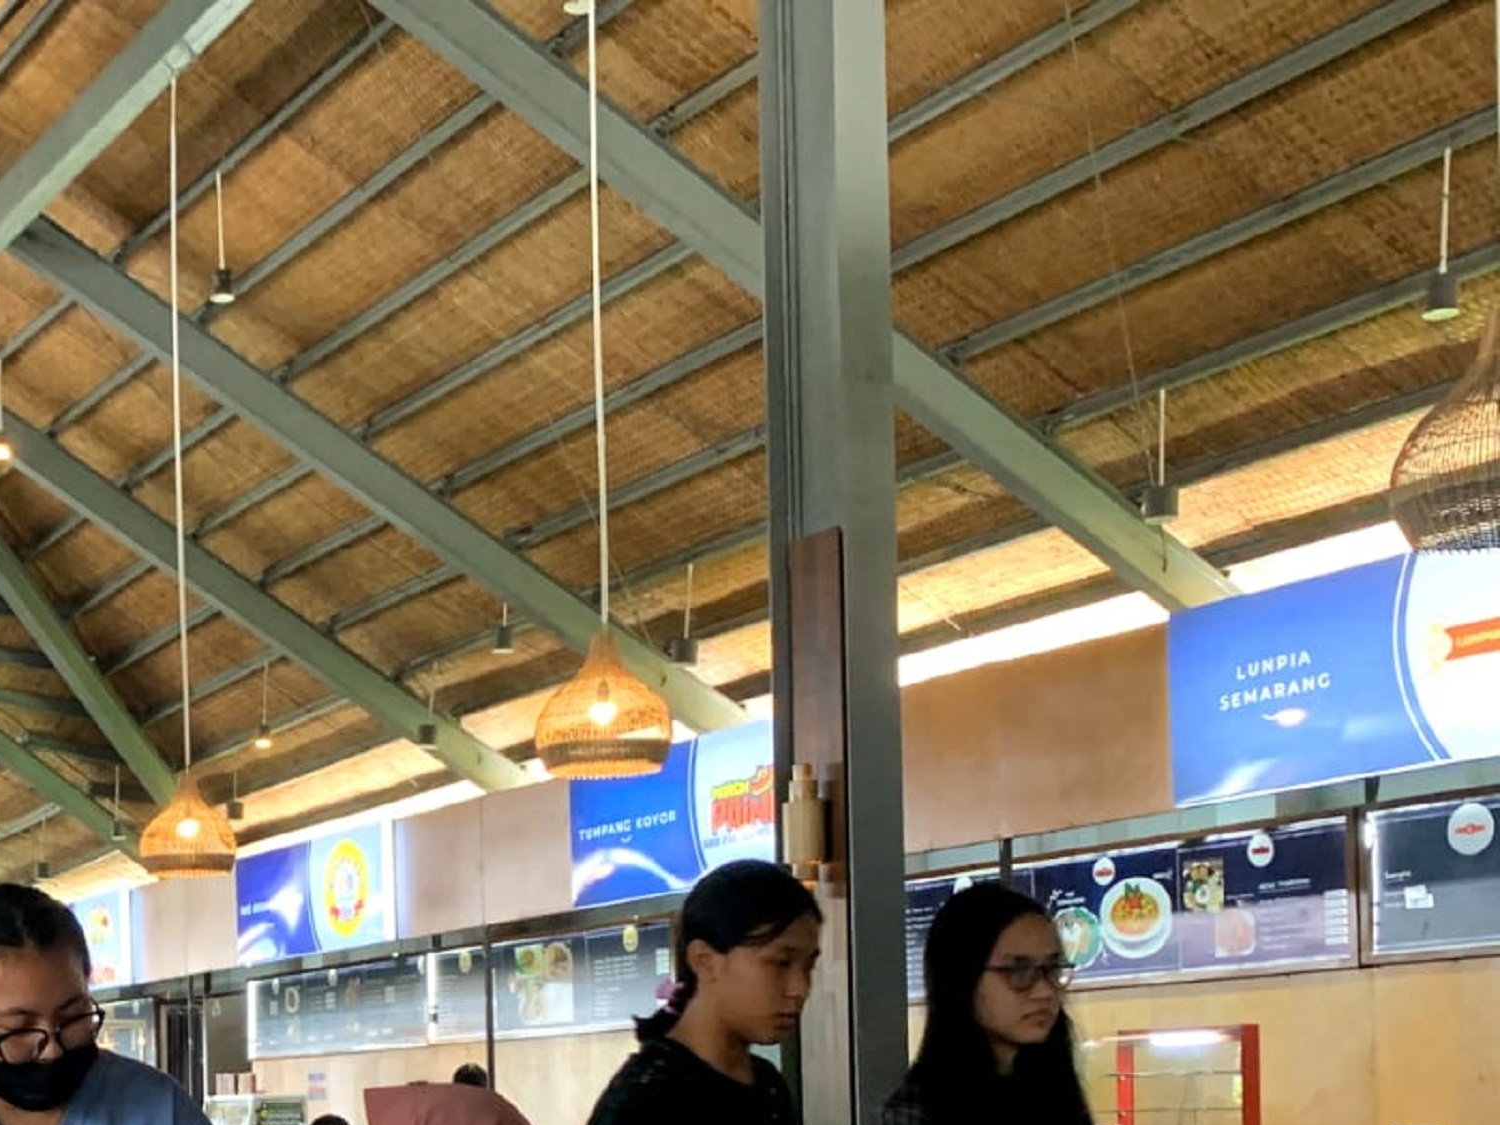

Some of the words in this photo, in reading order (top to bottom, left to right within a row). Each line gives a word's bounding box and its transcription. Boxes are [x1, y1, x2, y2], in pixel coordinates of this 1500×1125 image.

[1235, 649, 1312, 681] LUNPIA
[1219, 672, 1331, 711] SEMARANG
[579, 818, 631, 841] TUMPANG
